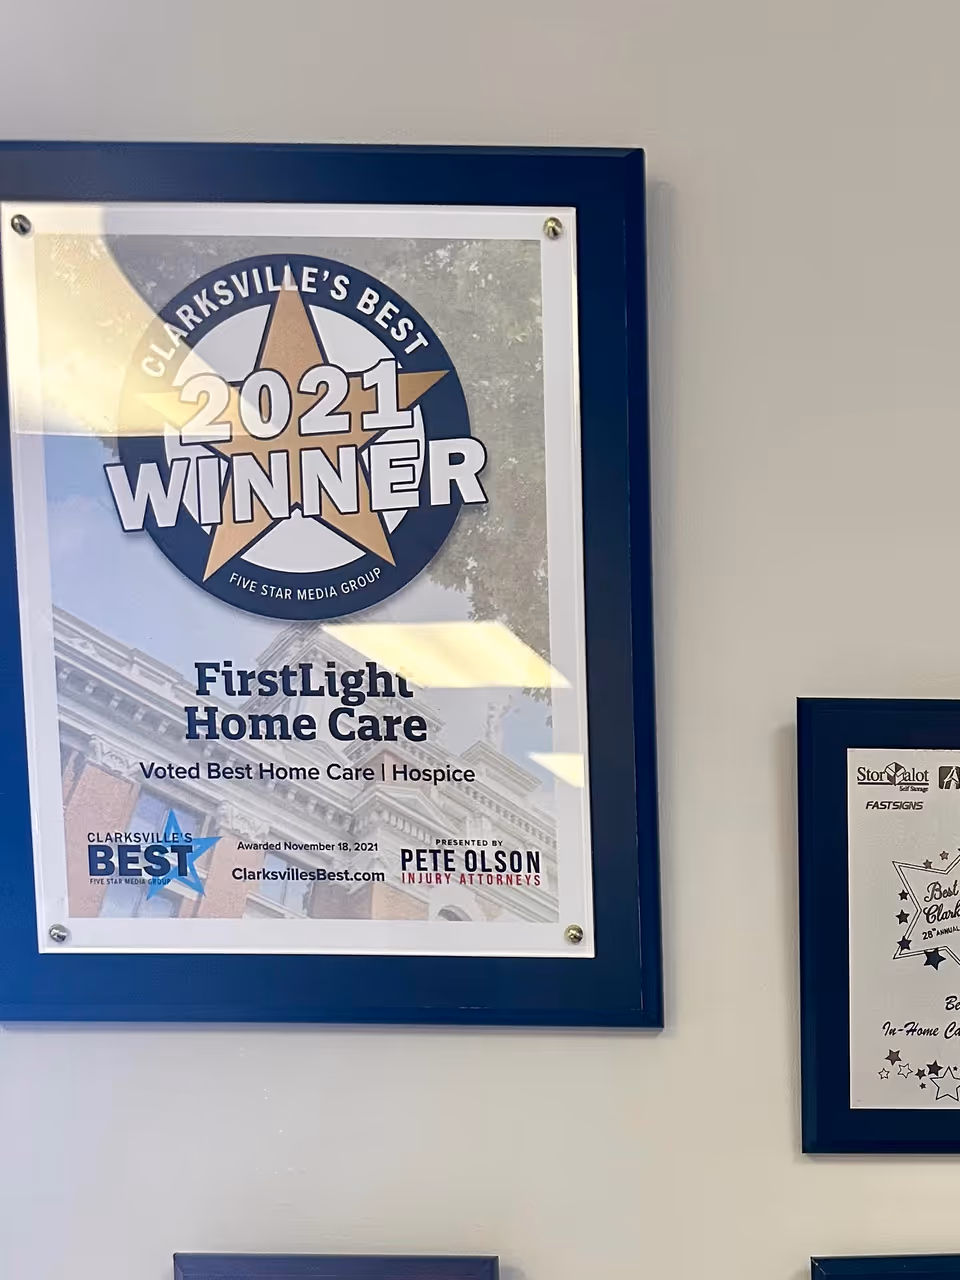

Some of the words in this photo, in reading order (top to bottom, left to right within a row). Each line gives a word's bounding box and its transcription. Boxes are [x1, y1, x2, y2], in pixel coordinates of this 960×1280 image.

[141, 264, 351, 378] CLARKSVILLE'S
[356, 286, 429, 355] BEST
[179, 358, 414, 444] 2021
[103, 437, 489, 532] WINNER
[229, 572, 257, 593] FIVE
[261, 583, 293, 600] STAR
[297, 585, 338, 600] MEDIA
[341, 566, 383, 595] GROUP
[184, 707, 317, 740] Home
[328, 707, 428, 742] Care
[139, 762, 200, 780] Voted
[207, 762, 253, 780] Best
[259, 763, 320, 780] Home
[326, 763, 375, 781] Care
[393, 765, 475, 786] Hospice
[866, 801, 923, 810] FASTSIGNS
[87, 832, 193, 844] CLARKSVILLE'S
[237, 841, 281, 850] Awarded
[284, 842, 335, 851] November
[337, 843, 351, 852] 18,
[354, 843, 378, 852] 2021
[435, 839, 488, 847] PRESENTED
[88, 844, 193, 877] BEST
[401, 849, 456, 872] PETE
[464, 850, 541, 874] OLSON
[232, 867, 385, 882] ClarksvillesBest.com
[402, 873, 451, 885] INJURY
[459, 873, 541, 886] ATTORNEYS
[924, 879, 959, 902] Best
[936, 926, 960, 936] ANNUAL
[882, 1021, 939, 1037] In-Home
